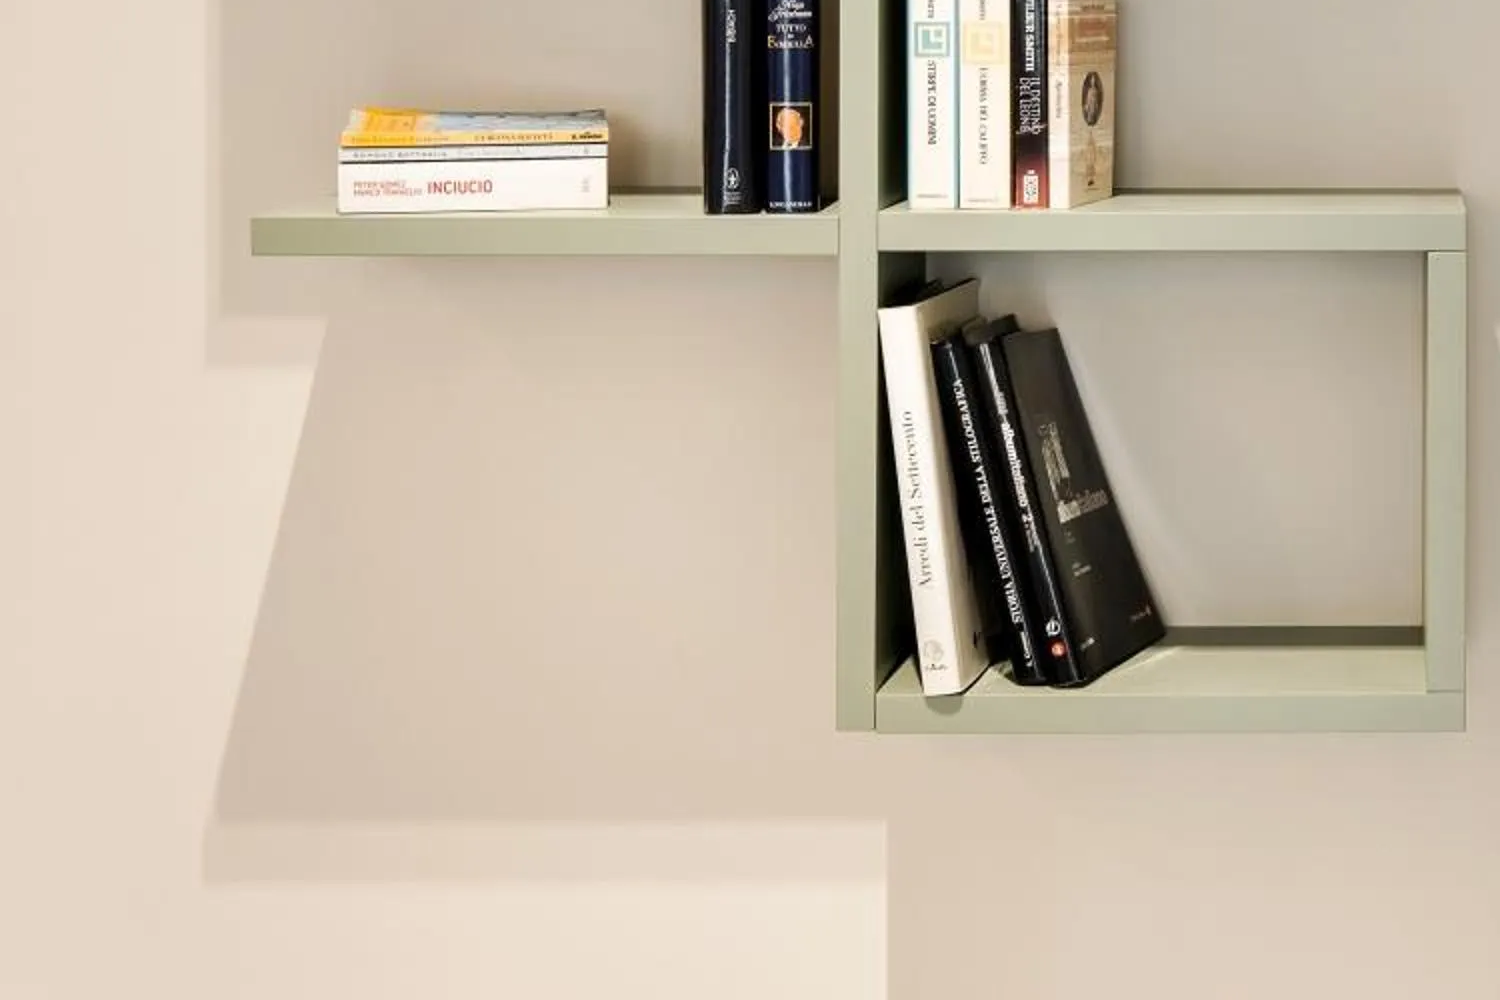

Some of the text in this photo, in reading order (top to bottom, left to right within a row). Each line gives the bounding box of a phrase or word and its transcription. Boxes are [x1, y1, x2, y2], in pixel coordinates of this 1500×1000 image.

[1025, 34, 1035, 71] SMITH
[1017, 77, 1031, 135] DEL LEONE
[1031, 89, 1047, 134] DESTINO
[427, 179, 494, 195] INCIUCIO
[902, 411, 932, 587] Arredi del Settecento
[953, 379, 1025, 624] STORIA UNIVERSALE DELLA STILOGRAFICA
